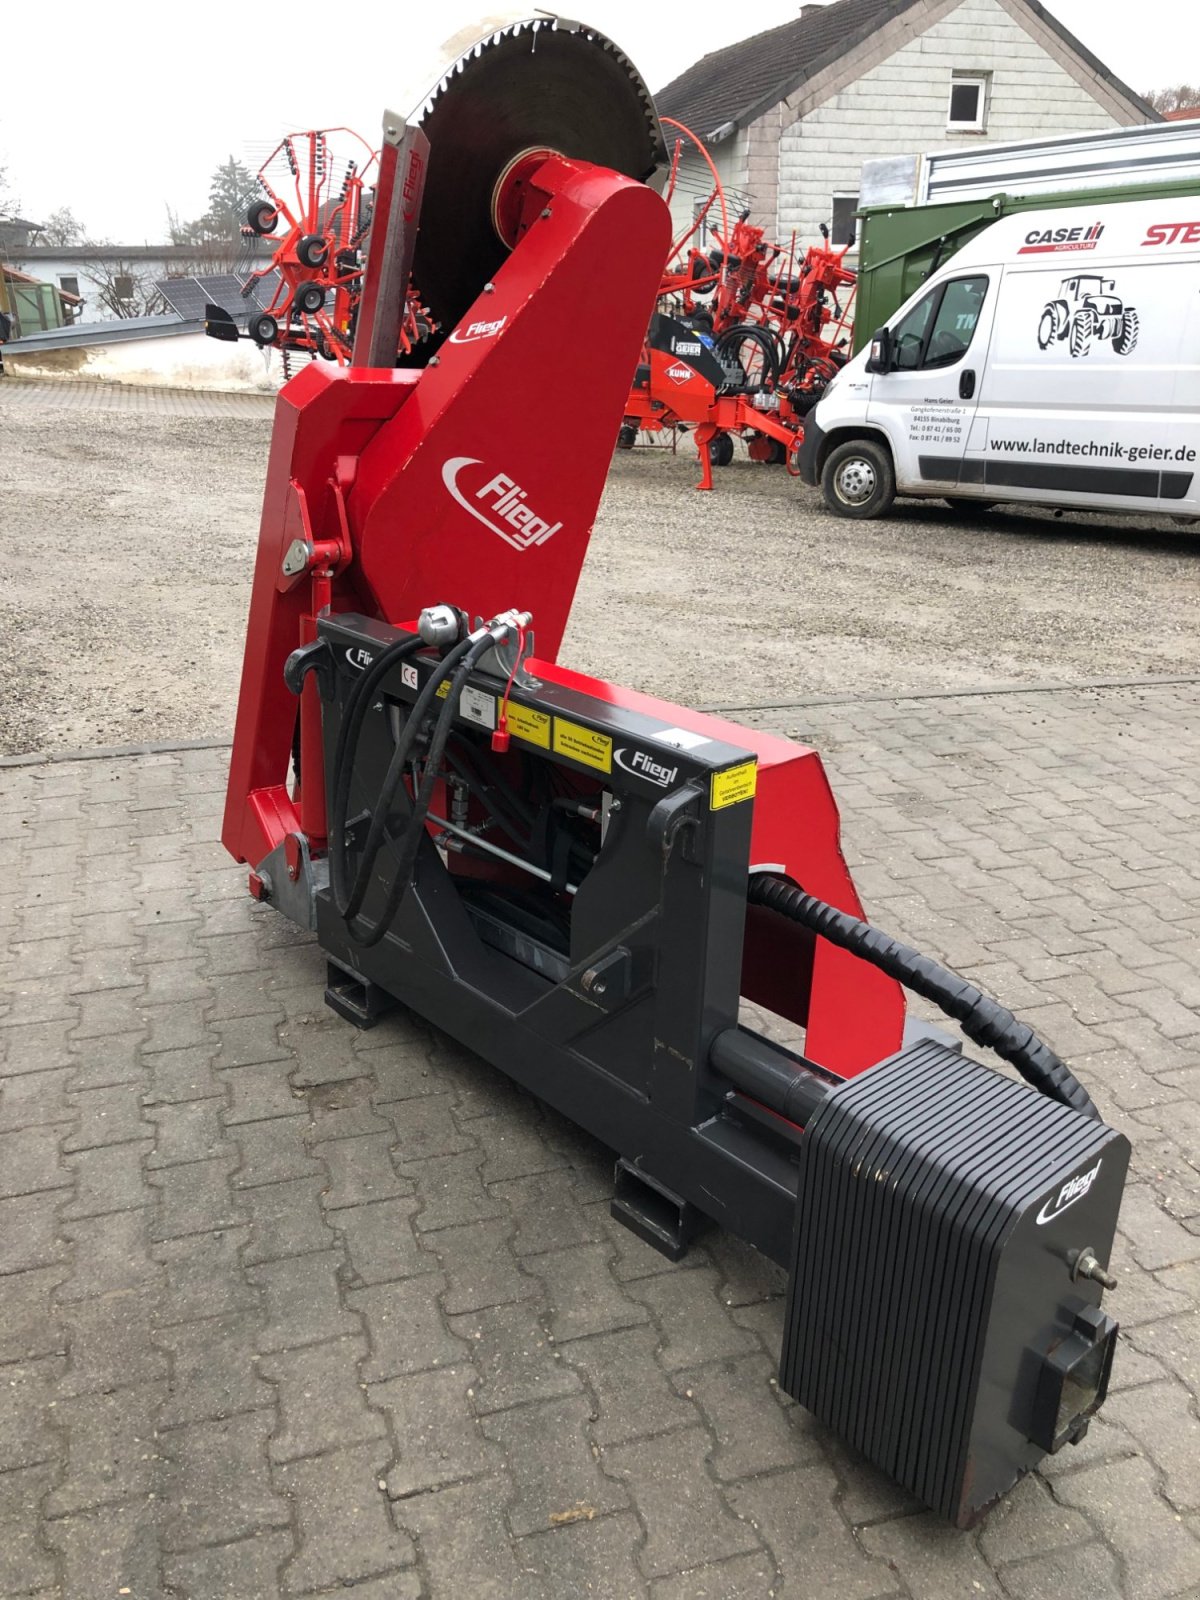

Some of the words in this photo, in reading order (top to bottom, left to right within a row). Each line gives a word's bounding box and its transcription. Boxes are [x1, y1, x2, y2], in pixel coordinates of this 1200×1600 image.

[403, 150, 422, 200] Fliegl
[1025, 227, 1084, 245] CASE
[1140, 222, 1200, 246] STE
[1054, 242, 1096, 251] AGRICULTURE
[465, 315, 508, 337] Fliegl
[675, 344, 702, 353] GEIER
[669, 368, 691, 379] KUHN
[923, 397, 938, 405] Hans
[938, 397, 954, 405] Geier
[990, 437, 1196, 462] www.landtechnik-geier.de
[475, 472, 564, 548] Fliegl
[403, 667, 416, 686] CE
[631, 751, 678, 785] Fliegl
[1055, 1158, 1103, 1209] Fliegl
